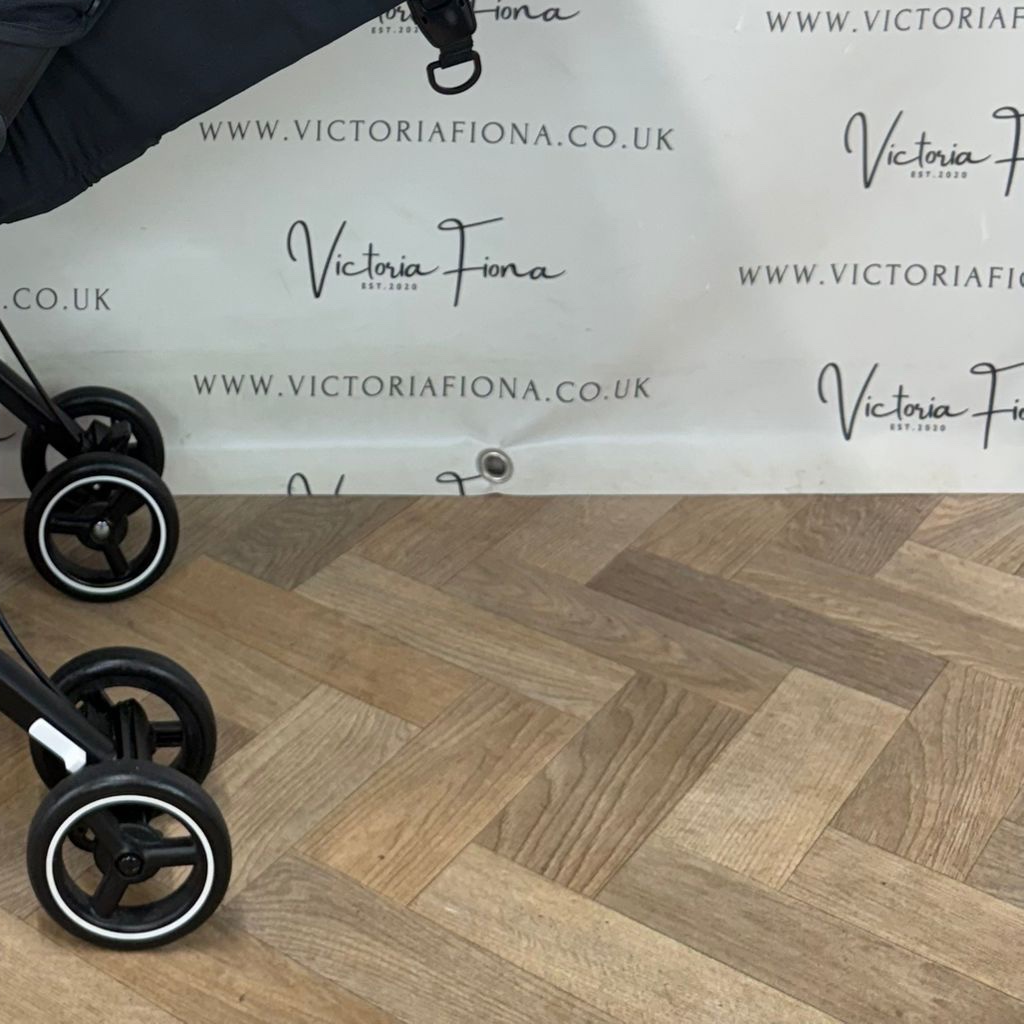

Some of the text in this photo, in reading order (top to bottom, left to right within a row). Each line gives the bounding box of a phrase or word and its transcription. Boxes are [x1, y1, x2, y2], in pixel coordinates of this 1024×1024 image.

[199, 120, 674, 151] WWW.VICTORIAFIONA.CO.UK
[844, 110, 991, 189] Victoria
[910, 171, 967, 179] EST.2020
[286, 217, 566, 307] Victoria Fiona
[738, 262, 1024, 290] WWW.VICTORIAFI
[361, 282, 417, 290] EST.2020
[193, 374, 650, 403] WWW.VICTORIAFIONA.CO.UK
[817, 362, 969, 441] Victoria
[890, 423, 946, 432] EST.2020
